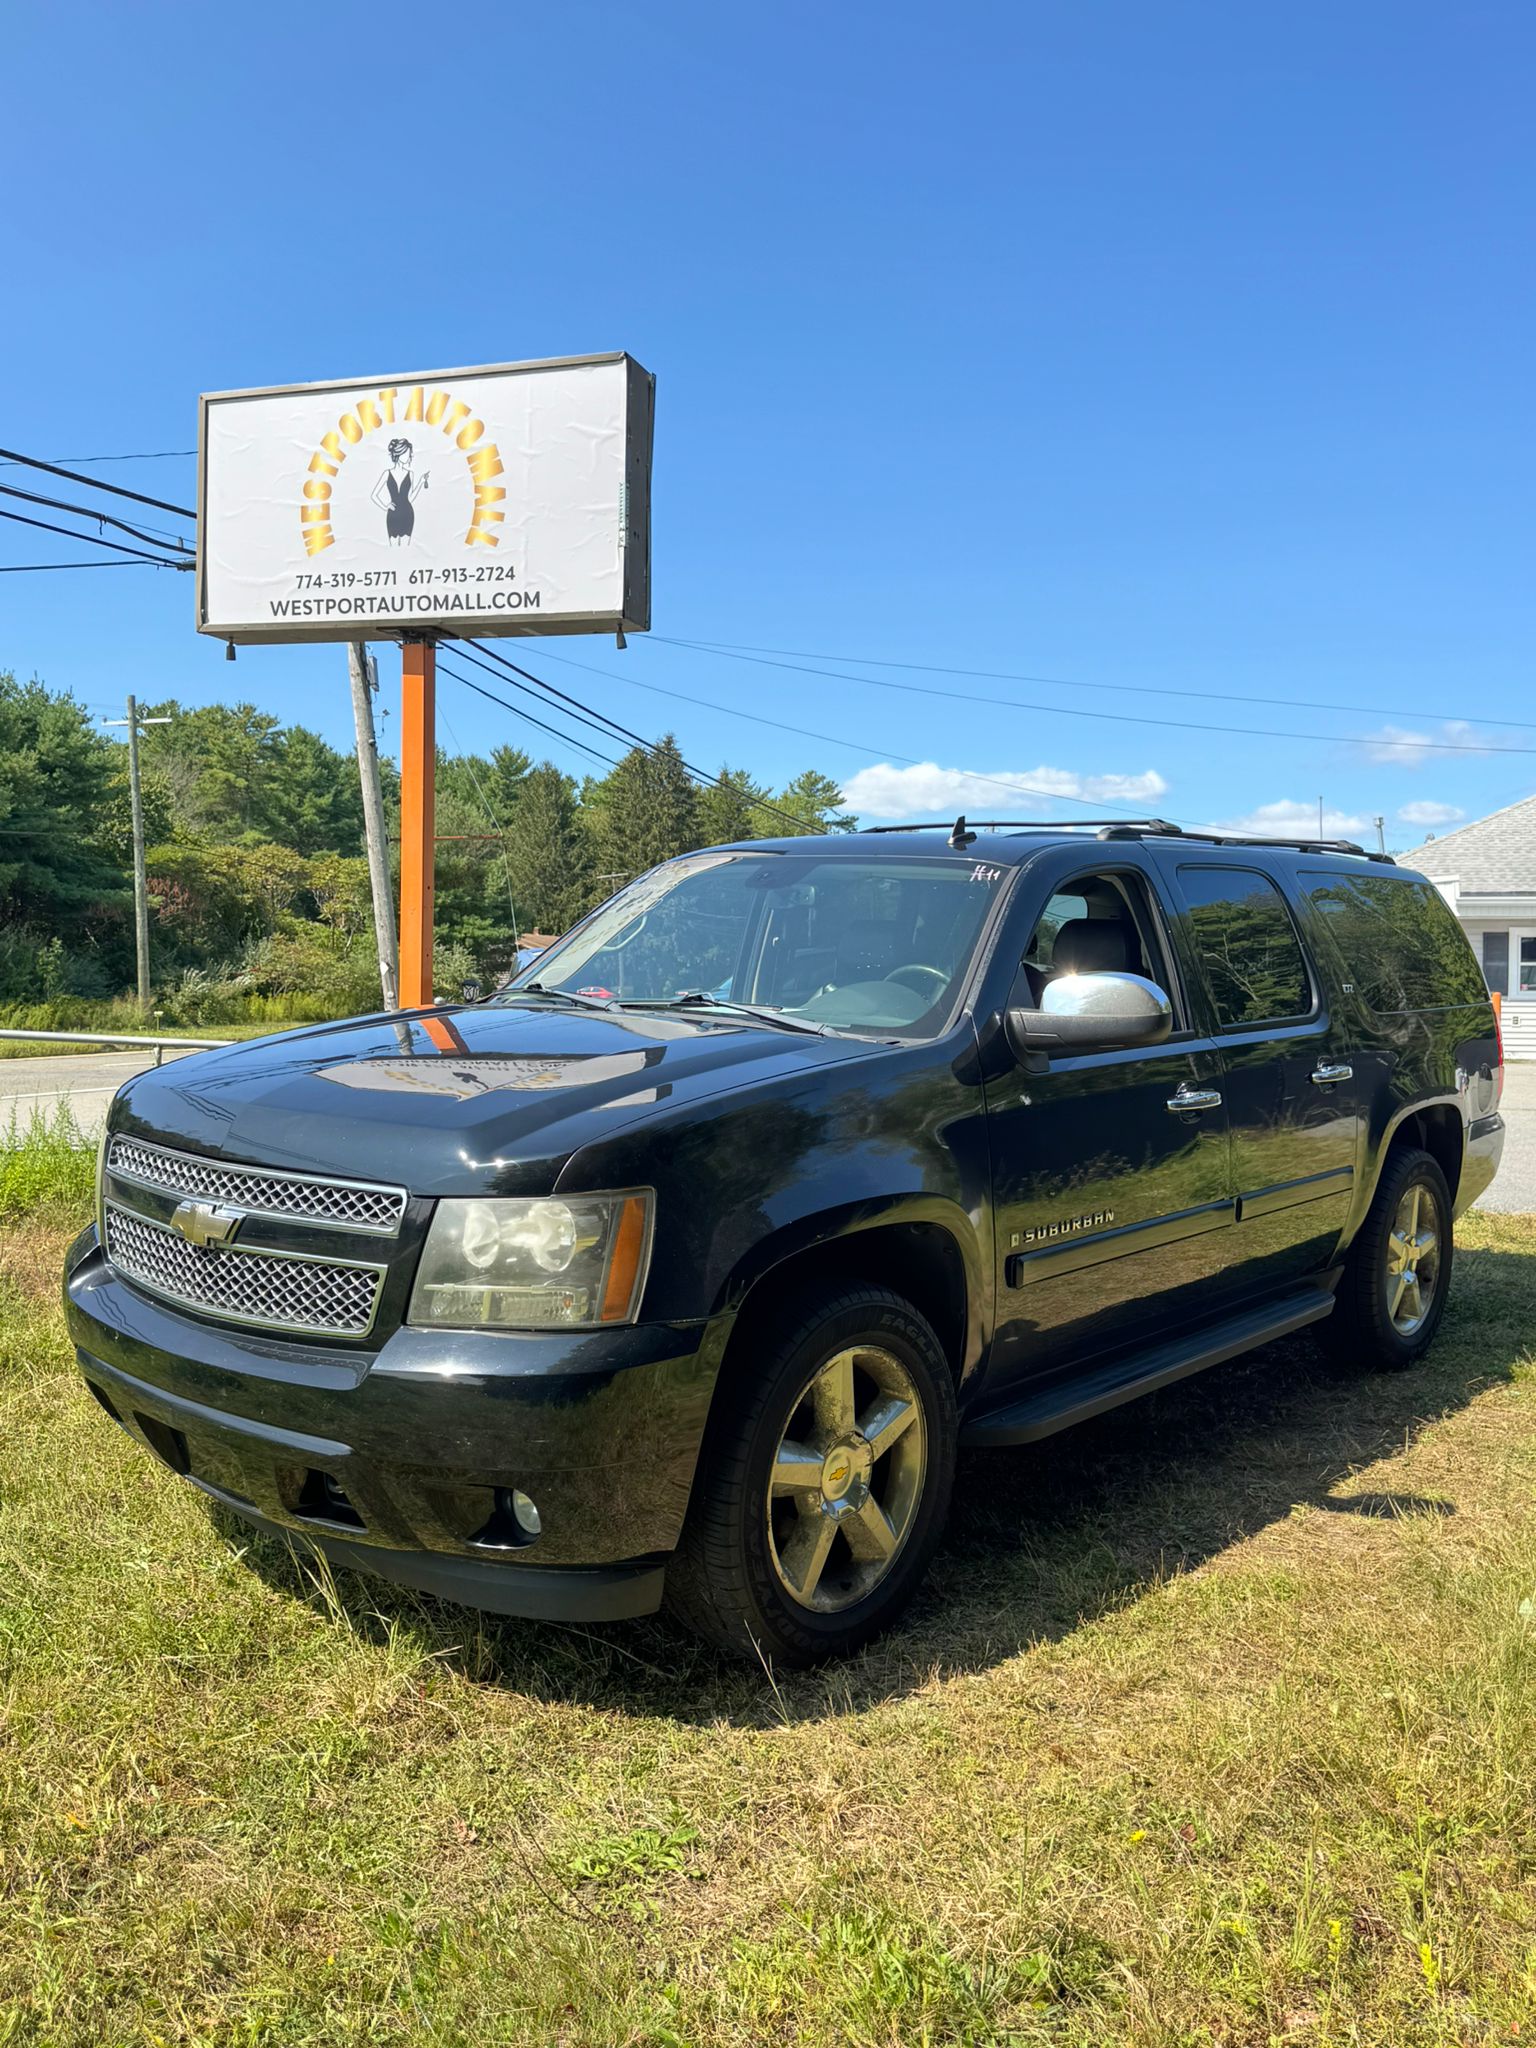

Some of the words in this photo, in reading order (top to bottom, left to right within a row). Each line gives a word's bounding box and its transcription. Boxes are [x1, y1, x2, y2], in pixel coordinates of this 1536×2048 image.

[301, 388, 398, 557] WESTPORT
[296, 571, 397, 589] 774-319-5771
[408, 566, 516, 585] 617-913-2724
[270, 591, 541, 616] WESTPORTAUTOMALL.COM
[1024, 1208, 1115, 1243] SUBURBAN
[879, 1313, 939, 1365] EAGLE
